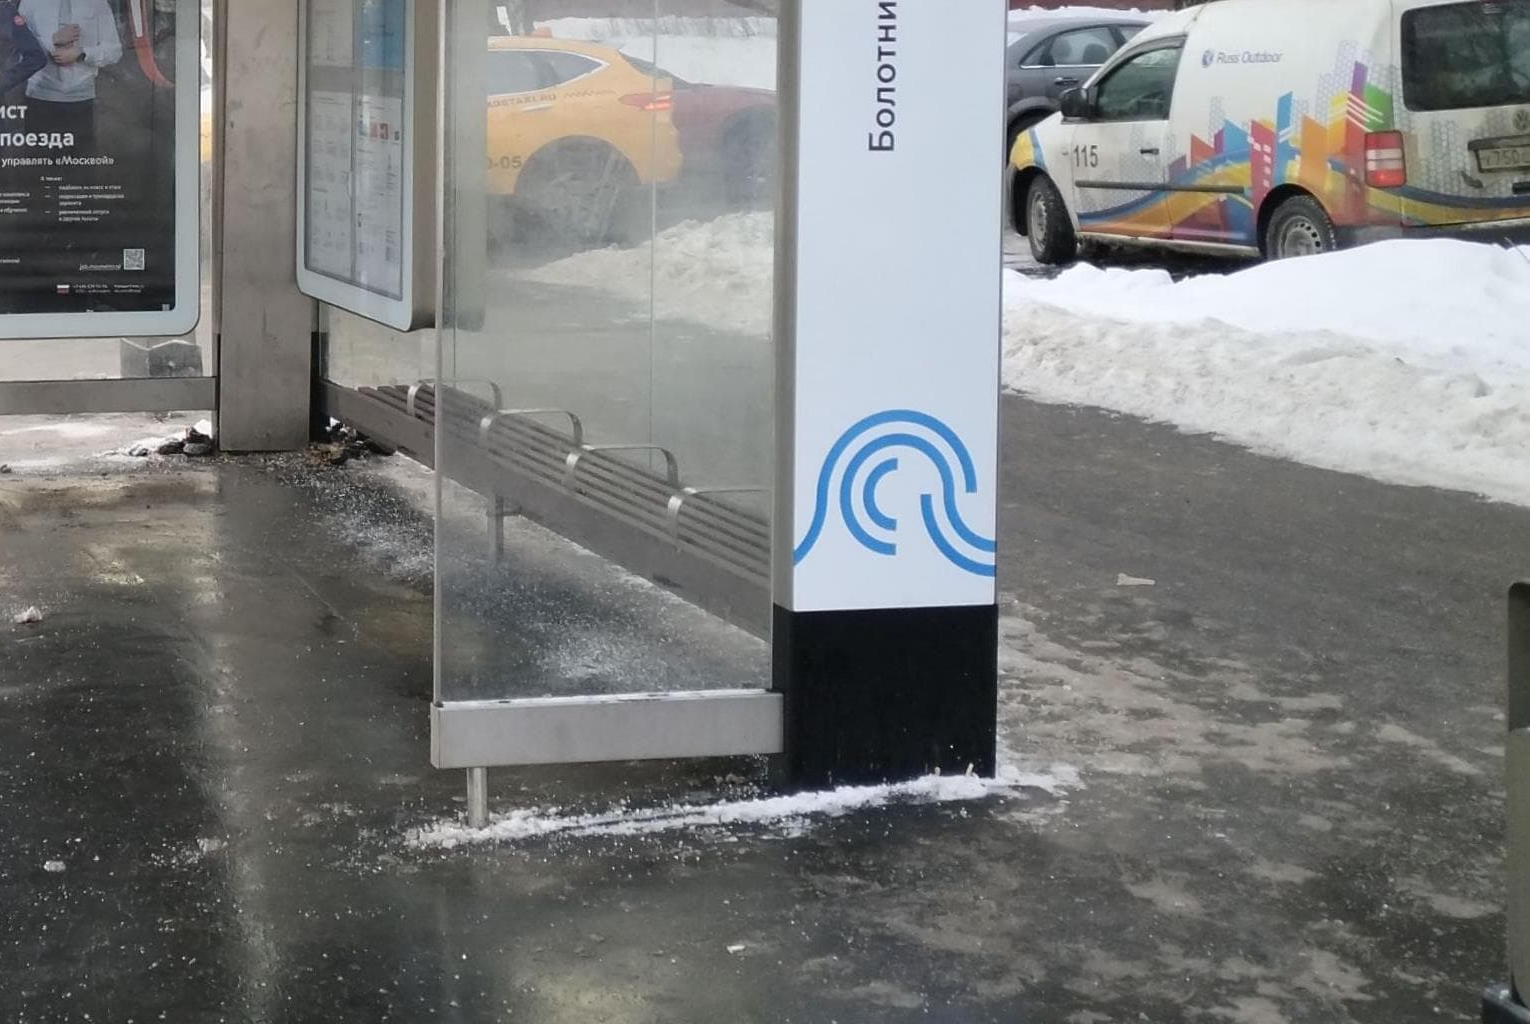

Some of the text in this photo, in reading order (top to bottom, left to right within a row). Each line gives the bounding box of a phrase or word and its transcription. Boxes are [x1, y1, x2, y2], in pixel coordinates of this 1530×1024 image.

[1216, 50, 1284, 64] Russ Outdoor
[1, 156, 54, 169] управлять
[55, 155, 115, 167] «Москвой»
[1073, 144, 1099, 168] 115
